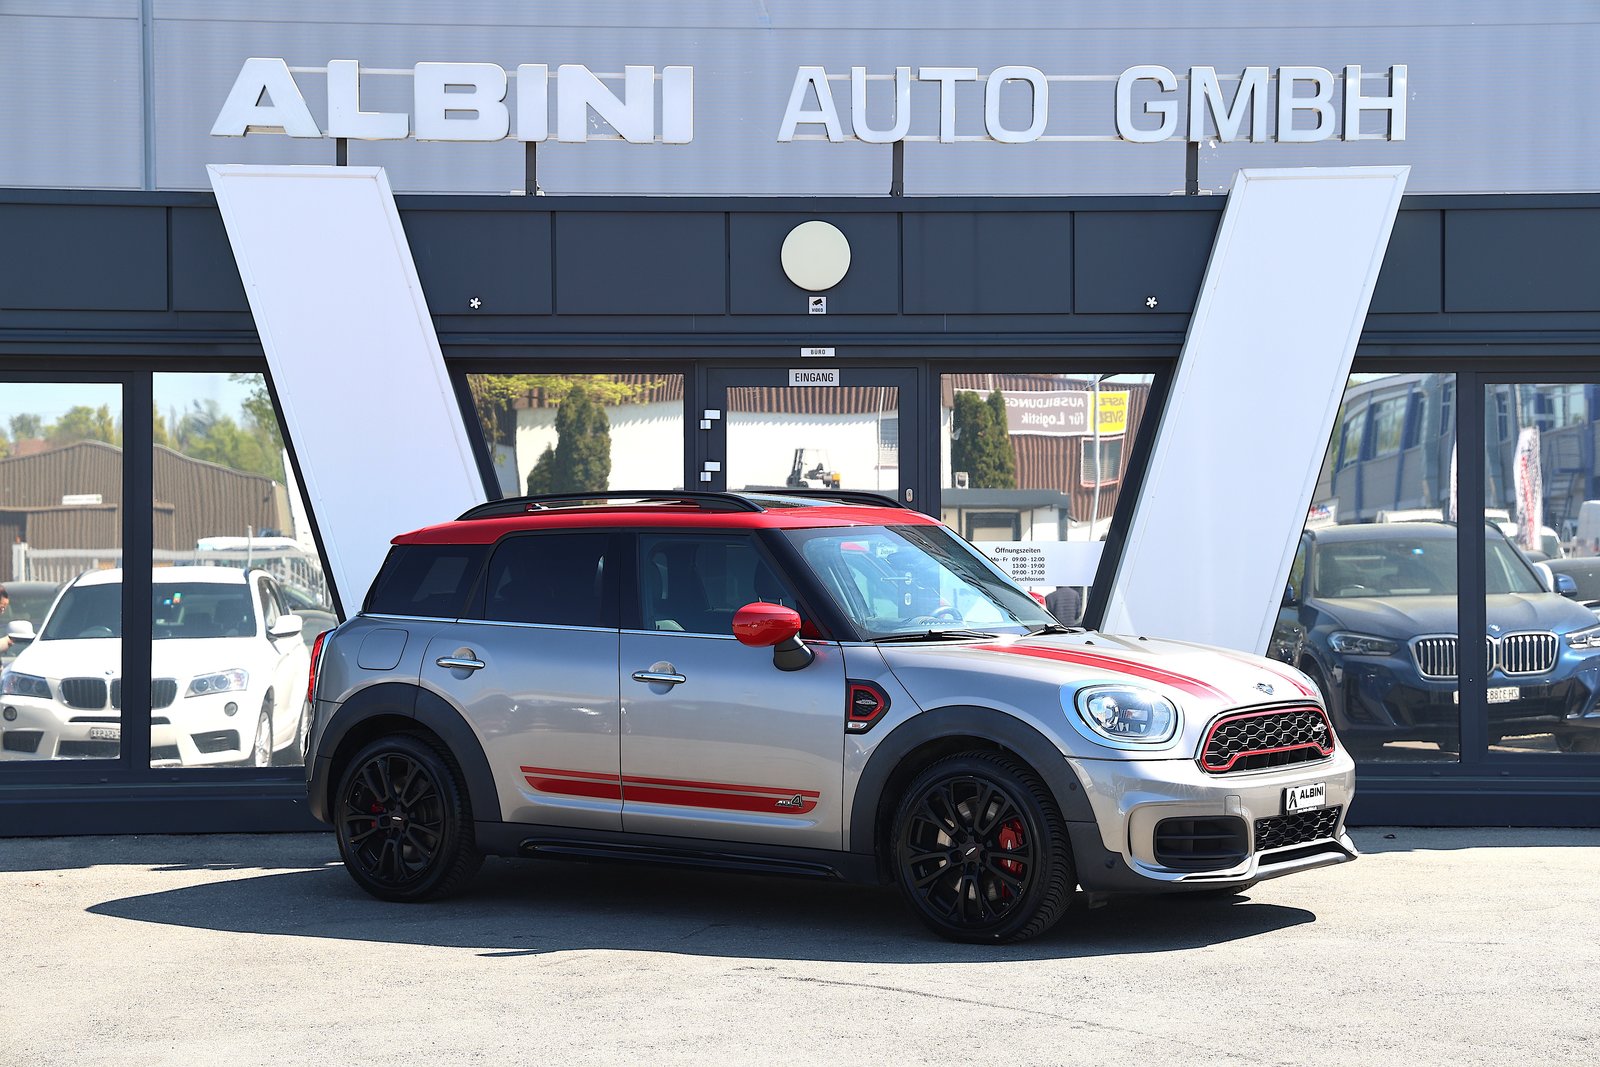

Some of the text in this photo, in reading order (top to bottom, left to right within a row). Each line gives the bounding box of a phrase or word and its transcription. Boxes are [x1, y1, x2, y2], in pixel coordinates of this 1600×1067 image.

[210, 57, 1408, 144] ALBINI AUTO GMBH
[794, 372, 834, 383] EINGANG
[995, 546, 1041, 554] Öffnungszeiten
[1299, 786, 1324, 799] ALBINI
